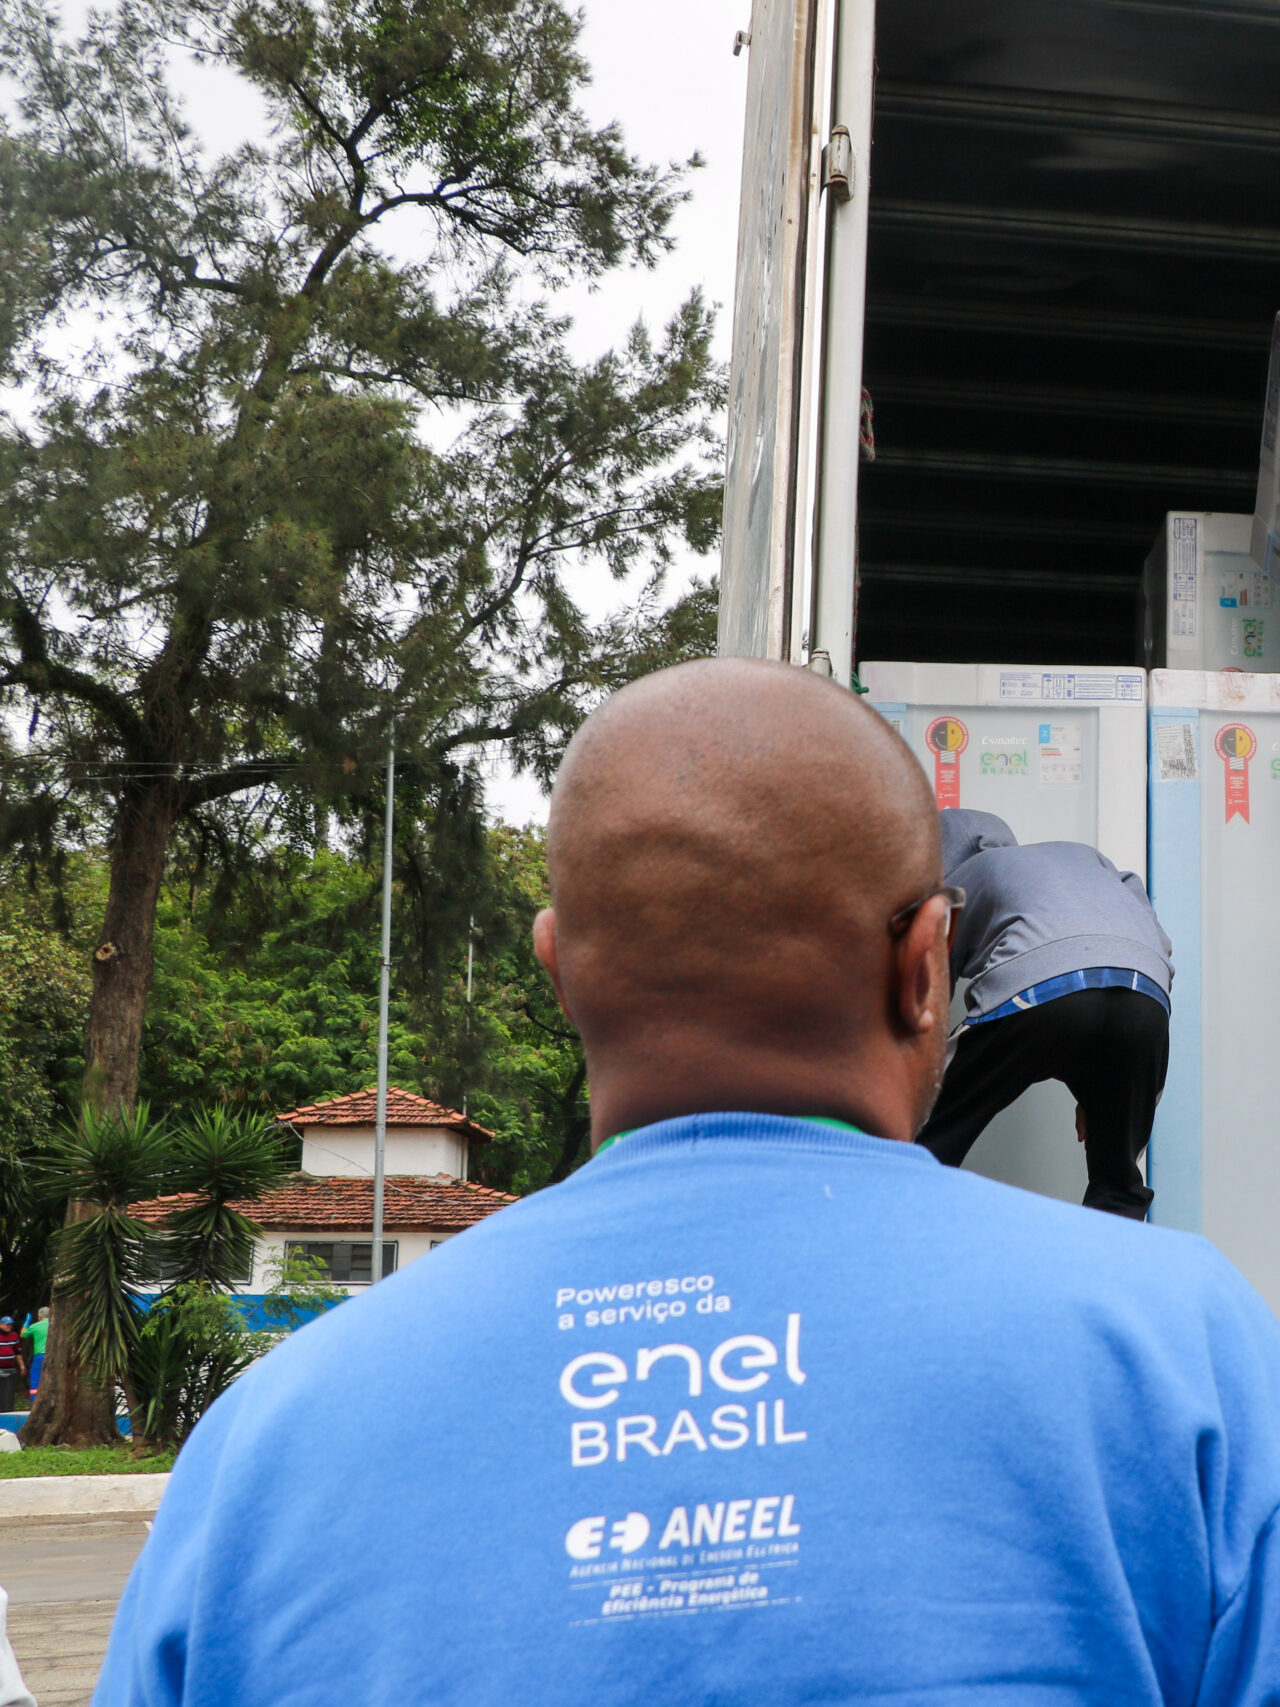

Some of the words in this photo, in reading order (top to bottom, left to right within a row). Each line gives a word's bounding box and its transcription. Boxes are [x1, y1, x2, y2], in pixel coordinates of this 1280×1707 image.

[1242, 617, 1257, 658] enel
[980, 751, 1029, 767] enel
[981, 767, 1028, 776] BRASIL
[556, 1274, 715, 1308] Poweresco
[558, 1312, 575, 1330] a
[585, 1298, 687, 1324] serviço
[696, 1293, 732, 1315] da
[559, 1312, 807, 1410] enel
[570, 1398, 808, 1467] BRASIL
[658, 1494, 801, 1549] ANEEL
[609, 1582, 643, 1599] PEE
[659, 1574, 736, 1596] Programa
[738, 1571, 760, 1585] de
